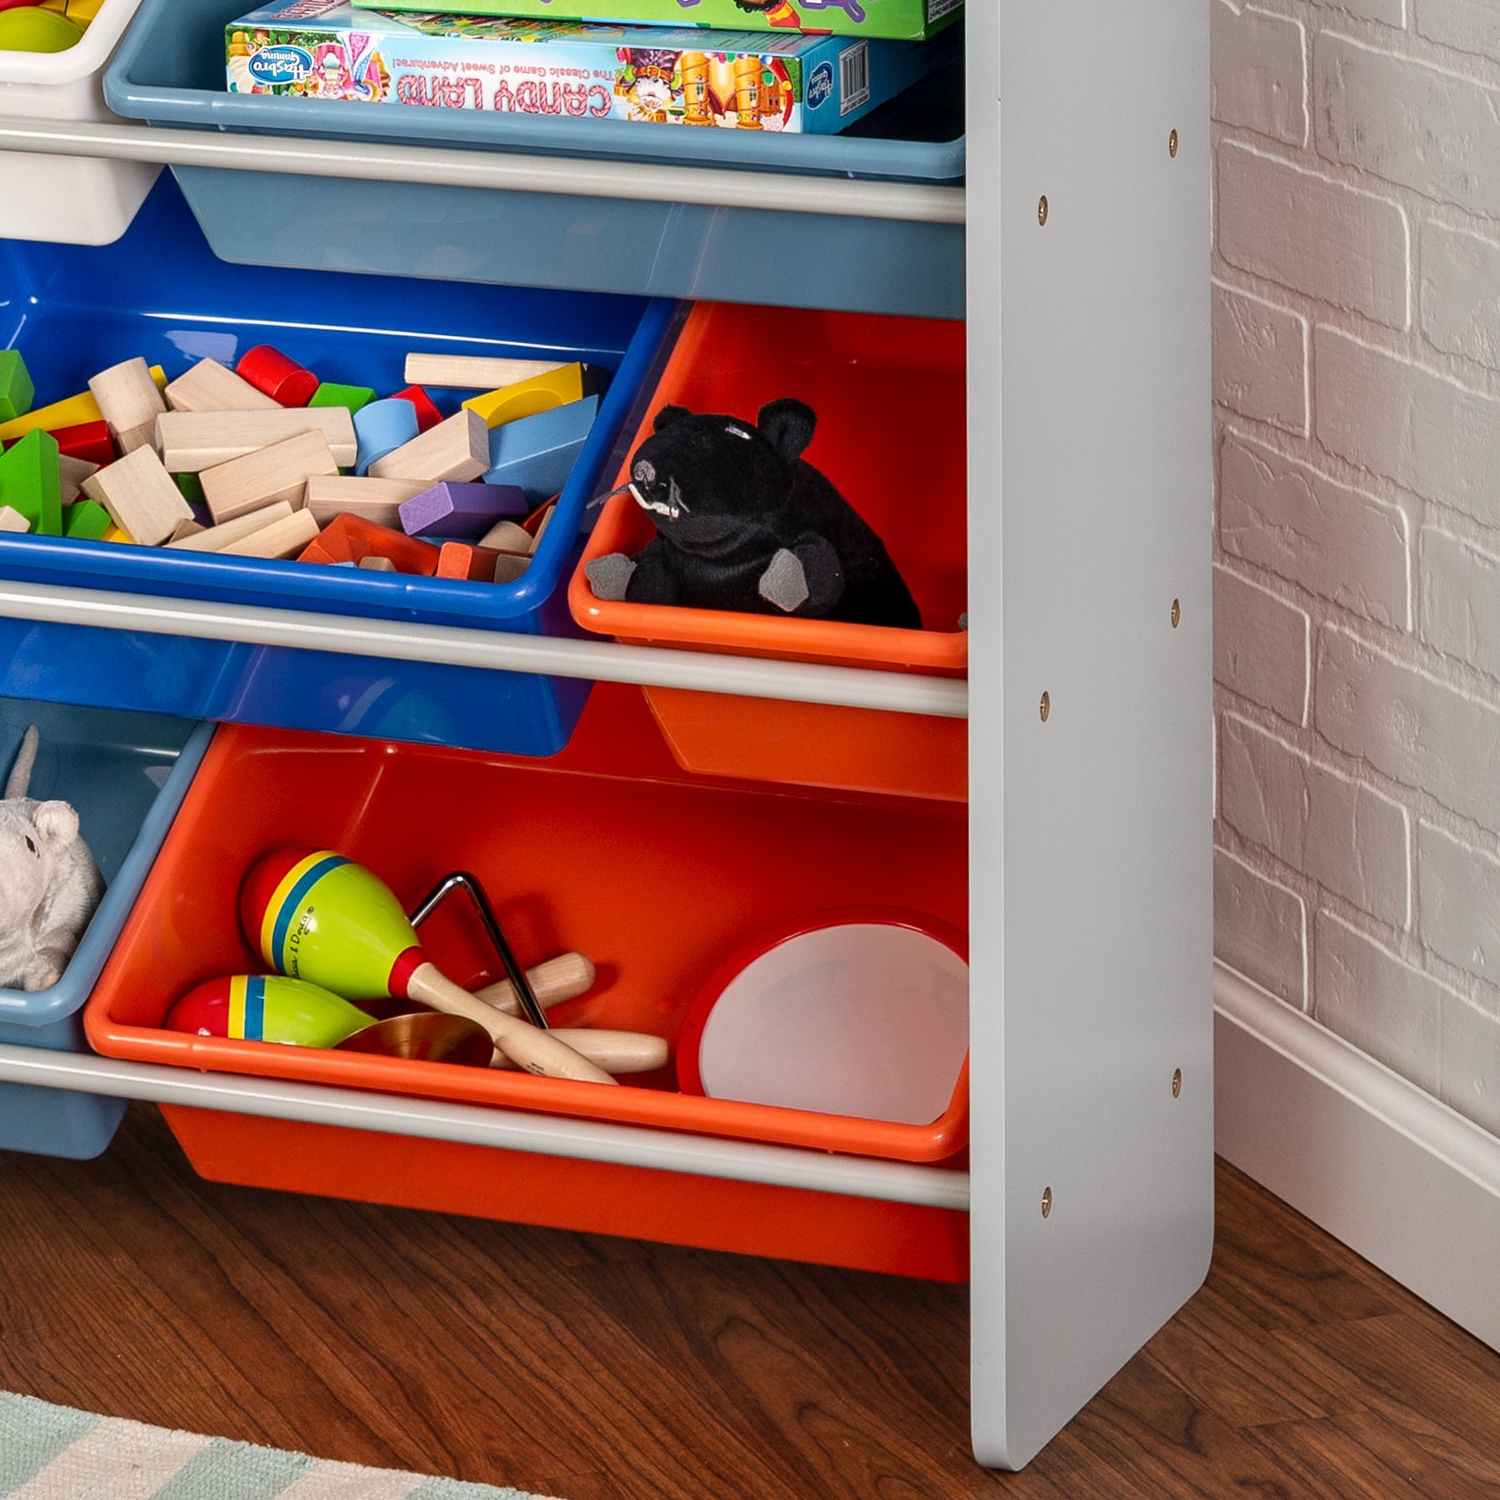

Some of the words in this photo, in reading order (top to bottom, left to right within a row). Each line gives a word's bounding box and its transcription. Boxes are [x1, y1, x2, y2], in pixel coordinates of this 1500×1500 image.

[253, 59, 311, 80] Hasbro
[392, 58, 458, 72] Adventures!
[460, 62, 495, 74] Sweet
[499, 65, 510, 75] of
[513, 65, 546, 76] Game
[549, 67, 589, 79] Classic
[593, 69, 614, 80] The
[395, 74, 483, 109] LAND
[493, 79, 611, 118] CANDY
